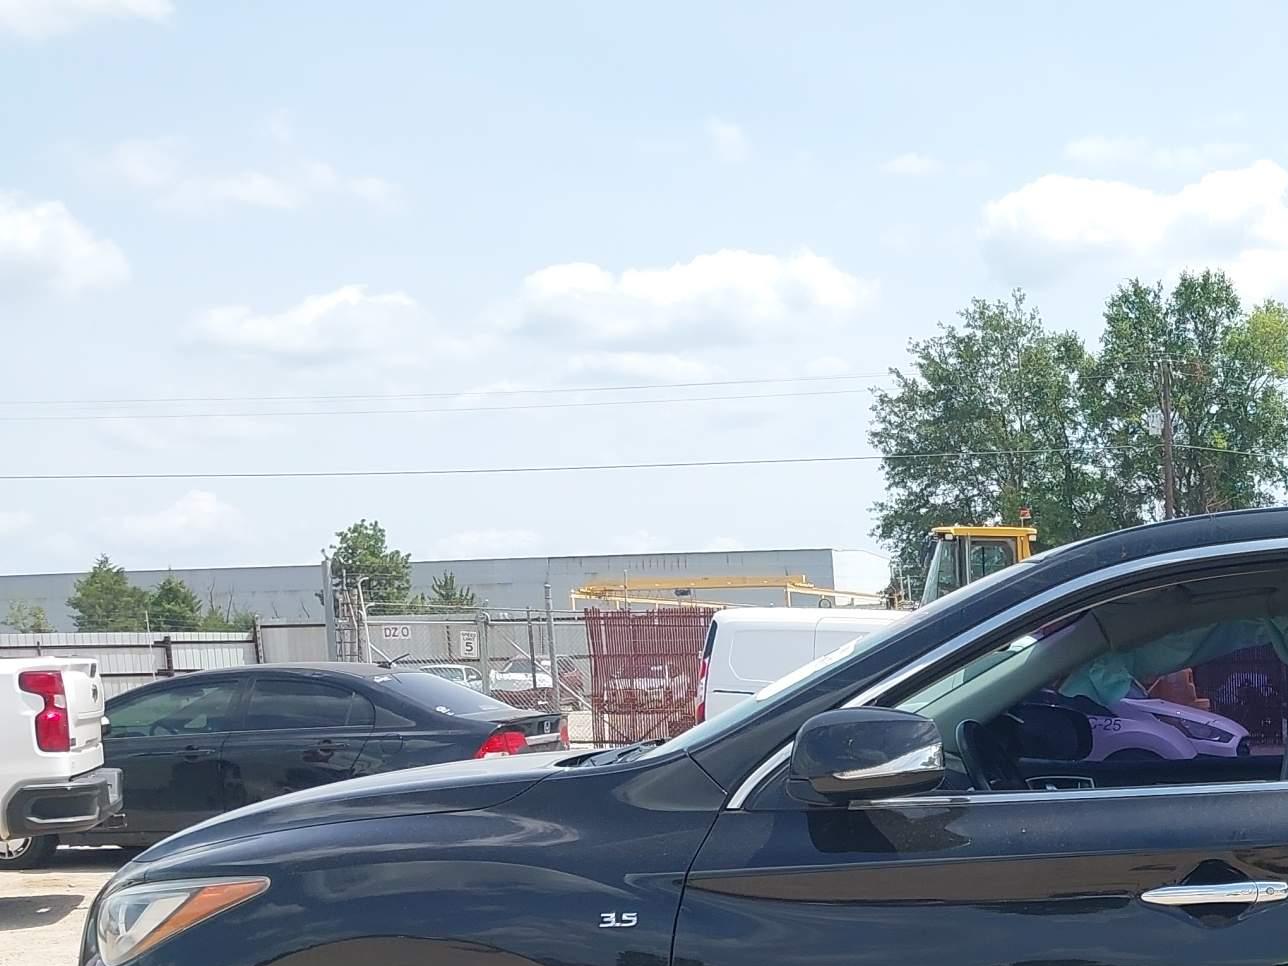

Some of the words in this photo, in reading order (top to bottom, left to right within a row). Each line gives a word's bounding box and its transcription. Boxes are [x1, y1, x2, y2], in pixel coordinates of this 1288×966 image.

[384, 627, 399, 638] DZ
[465, 642, 473, 652] 5
[599, 912, 638, 928] 3.5
